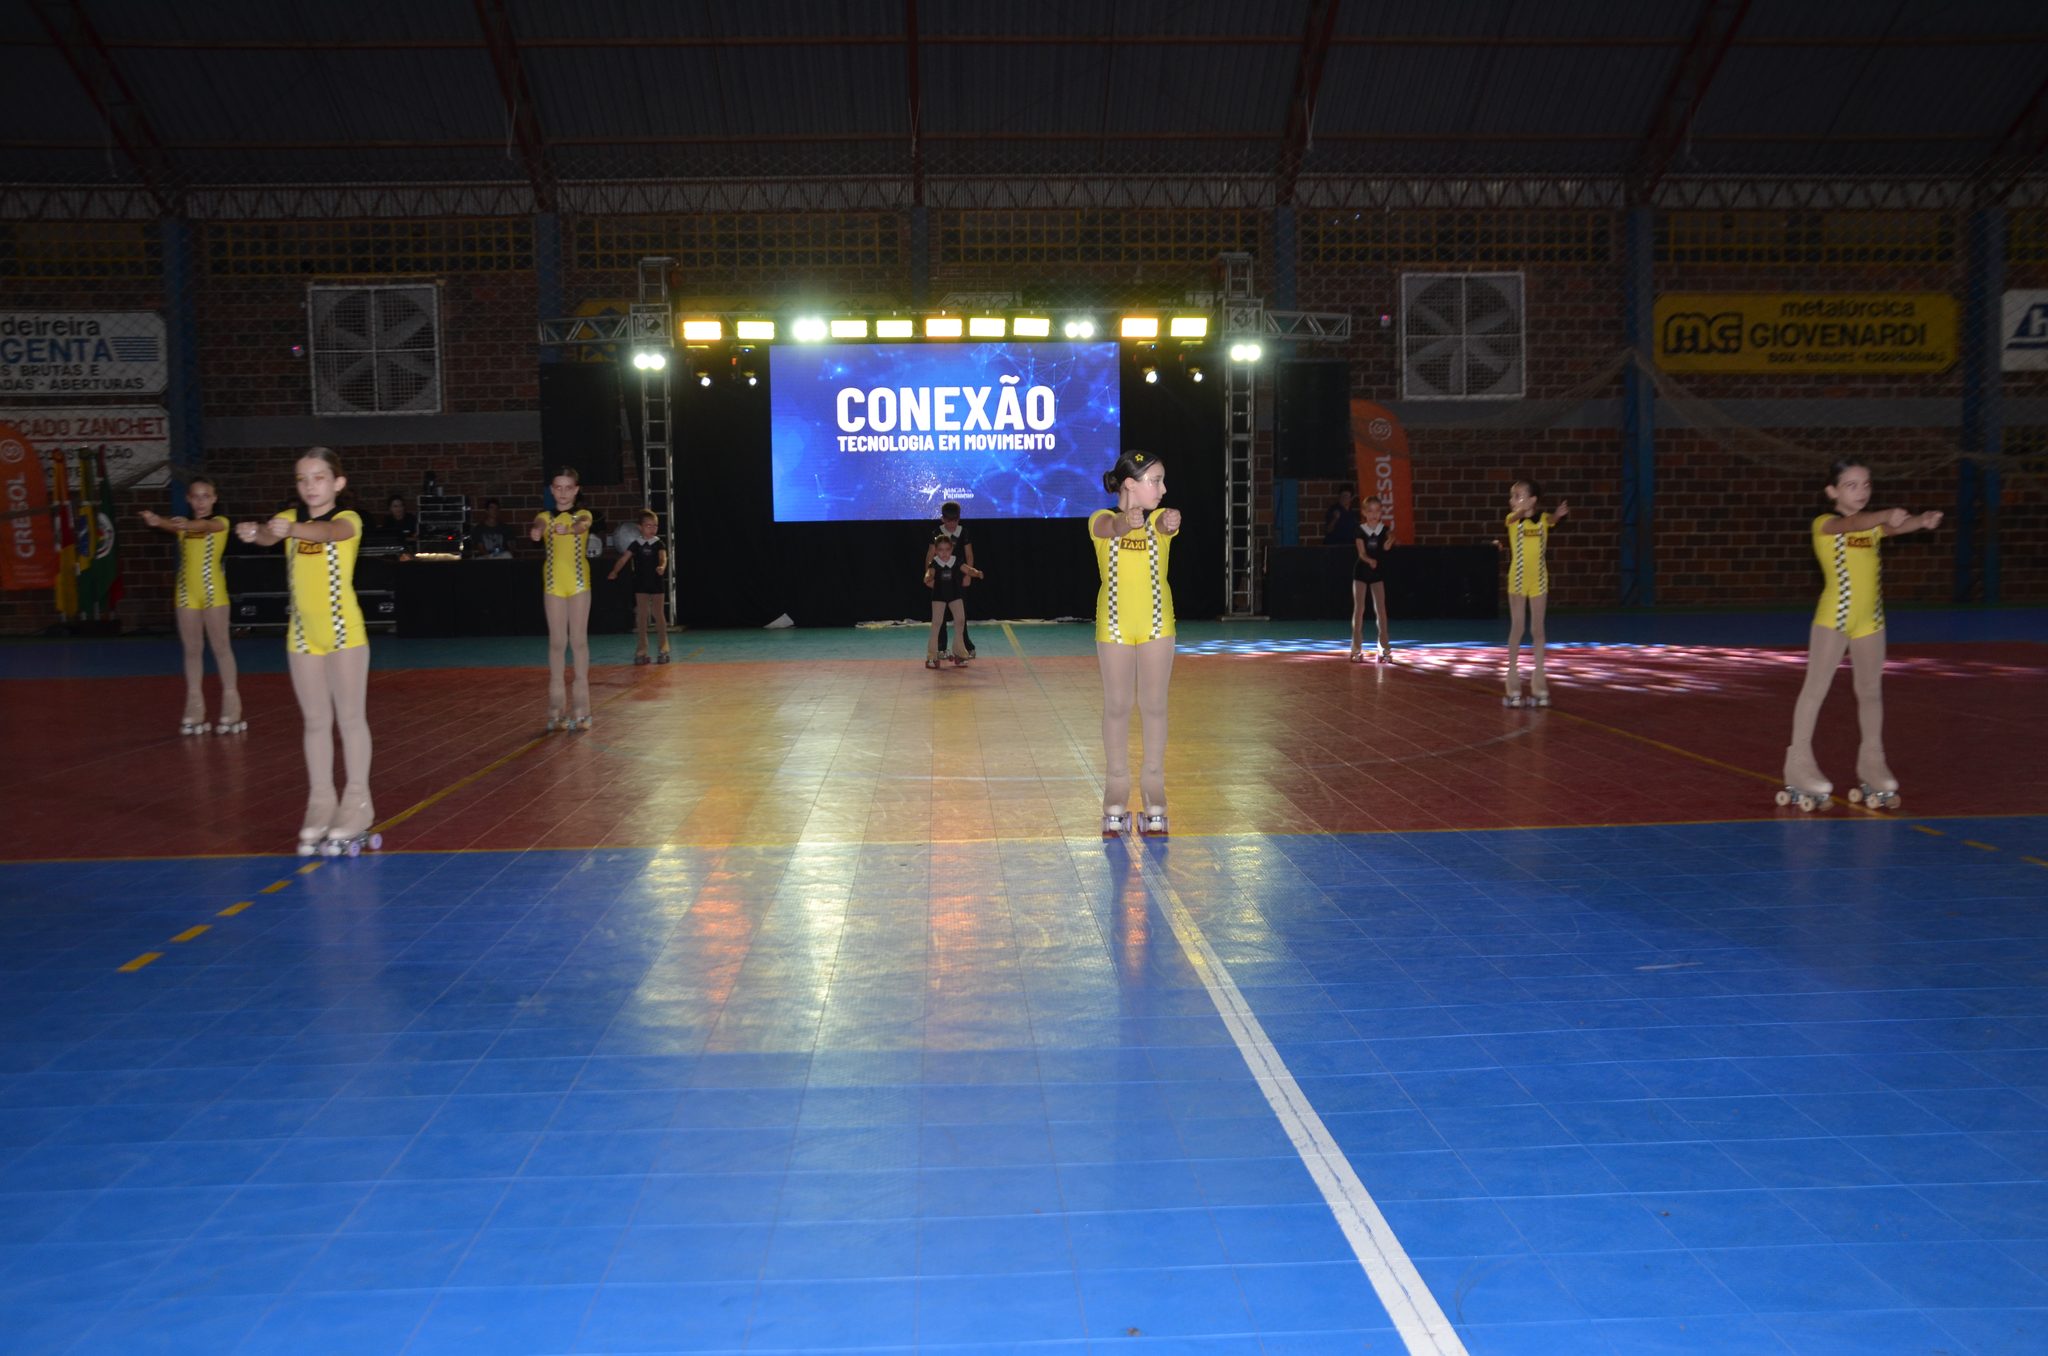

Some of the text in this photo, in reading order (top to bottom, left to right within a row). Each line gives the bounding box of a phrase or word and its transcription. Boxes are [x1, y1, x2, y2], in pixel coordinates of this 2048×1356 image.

[1749, 321, 1927, 348] GIOVENARDI
[21, 365, 83, 377] BRUTAS
[90, 365, 100, 377] E
[50, 378, 145, 391] ABERTURAS
[836, 374, 1056, 432] CONEXÃO
[77, 417, 165, 437] ZANCHET
[837, 433, 1056, 452] TECNOLOGIA EM MOVIMENTO
[1122, 539, 1146, 550] TAXI
